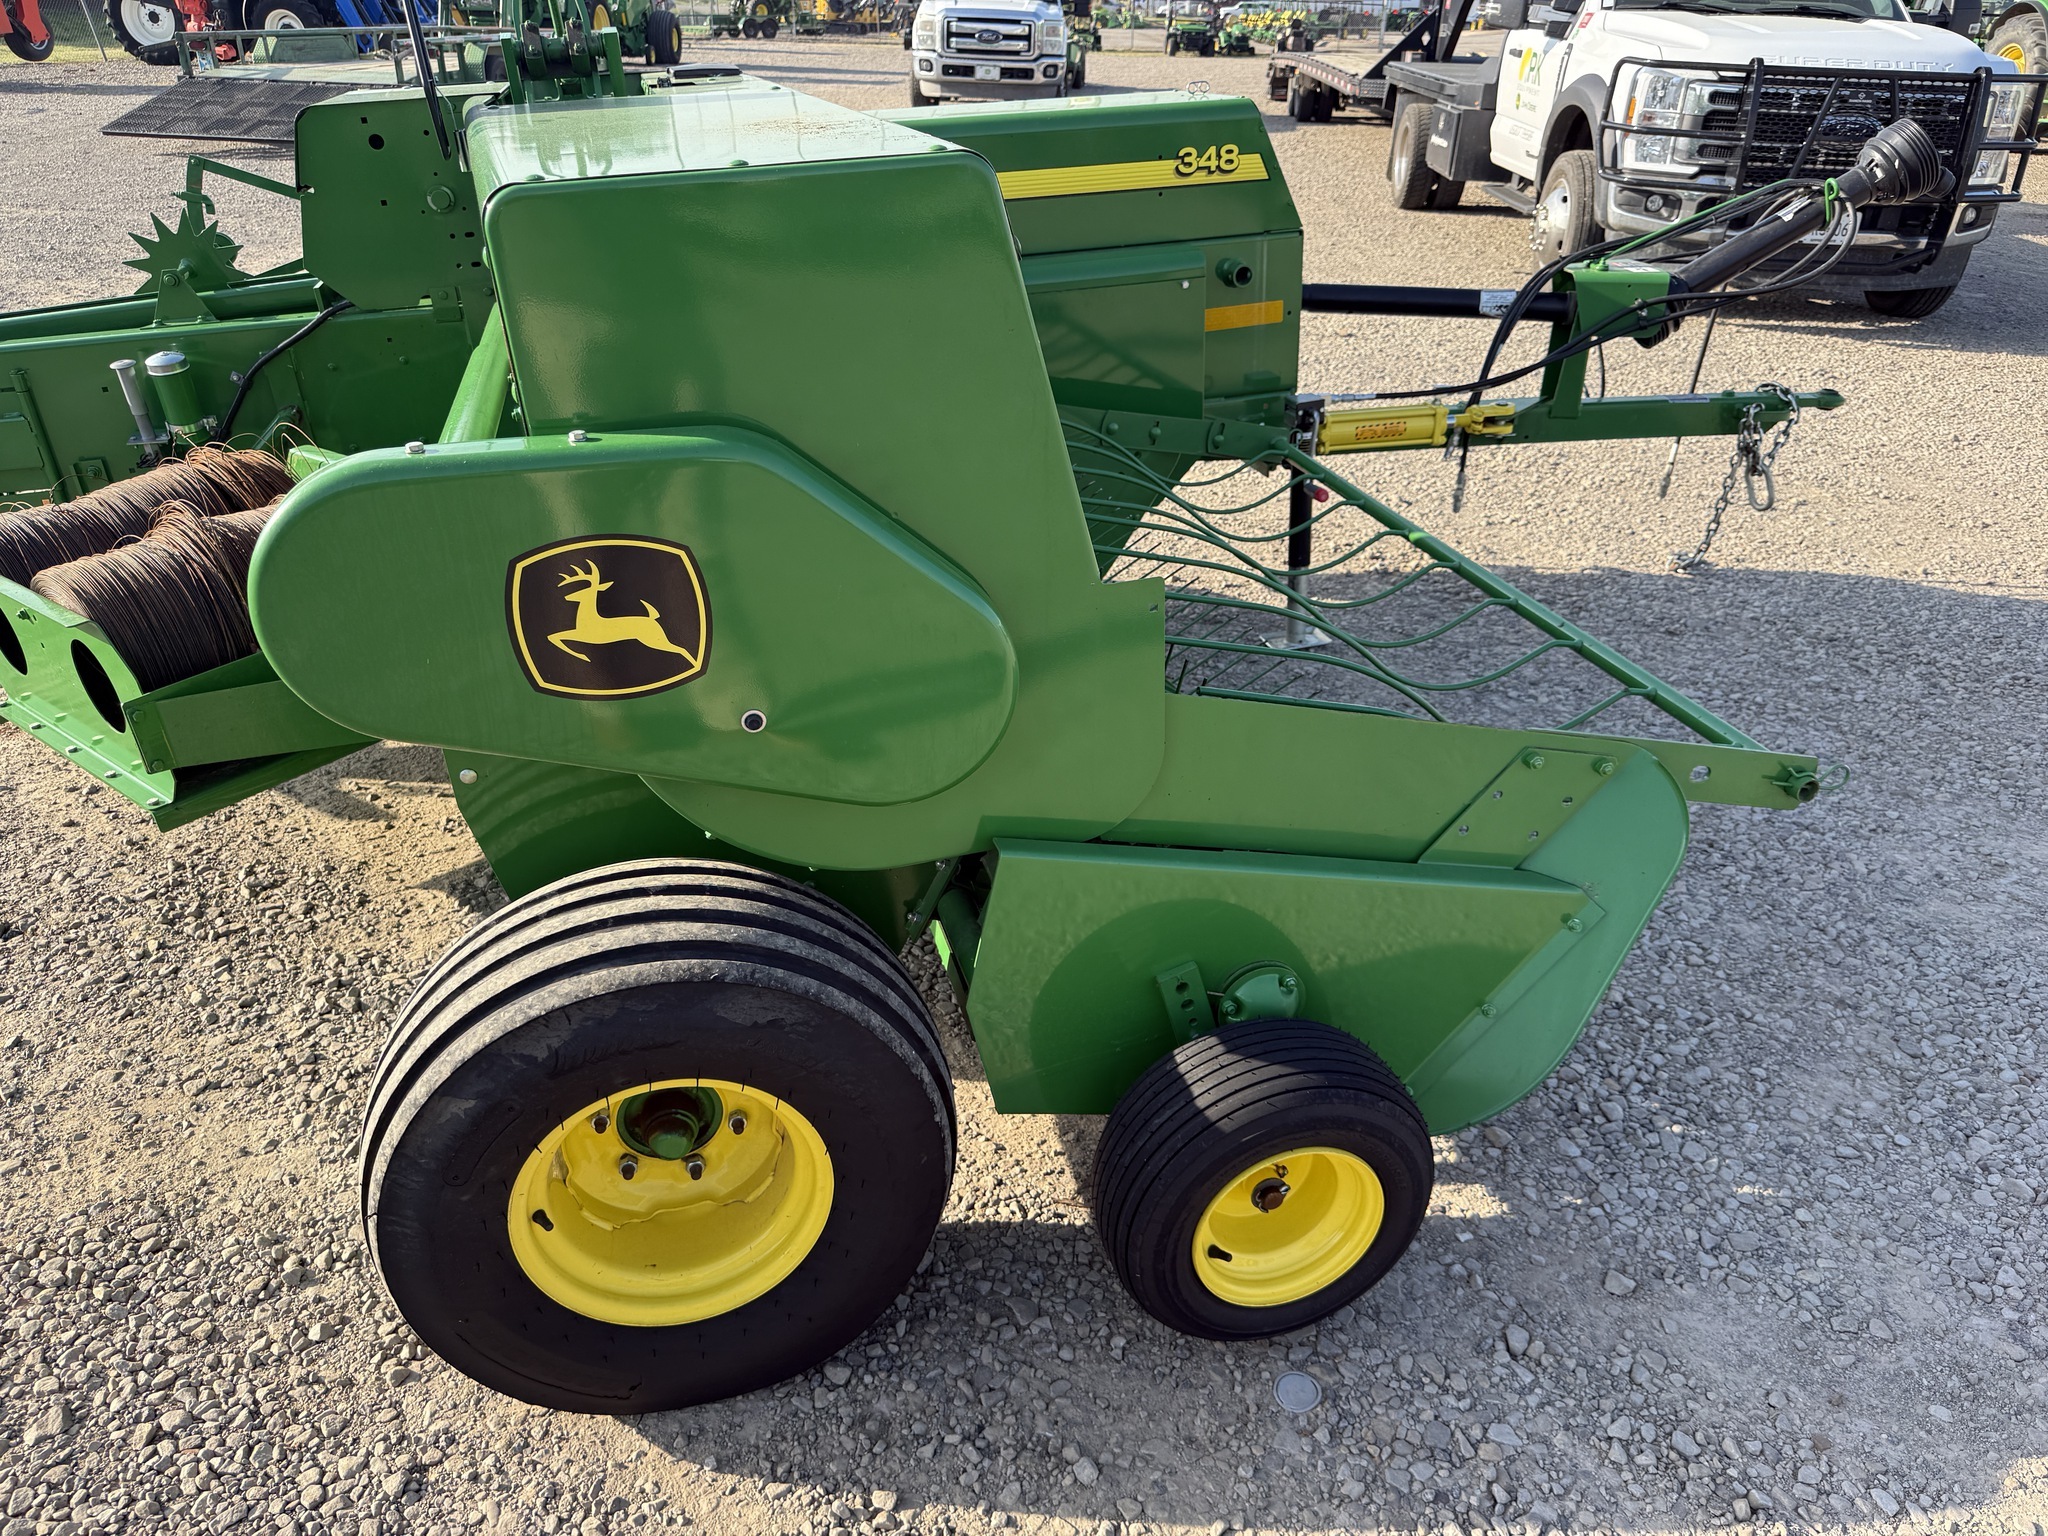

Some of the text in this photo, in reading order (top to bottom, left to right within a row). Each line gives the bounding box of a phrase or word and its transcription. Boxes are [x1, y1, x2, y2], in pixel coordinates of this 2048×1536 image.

[1761, 55, 1954, 72] SUPER DUTY
[1175, 144, 1240, 177] 348
